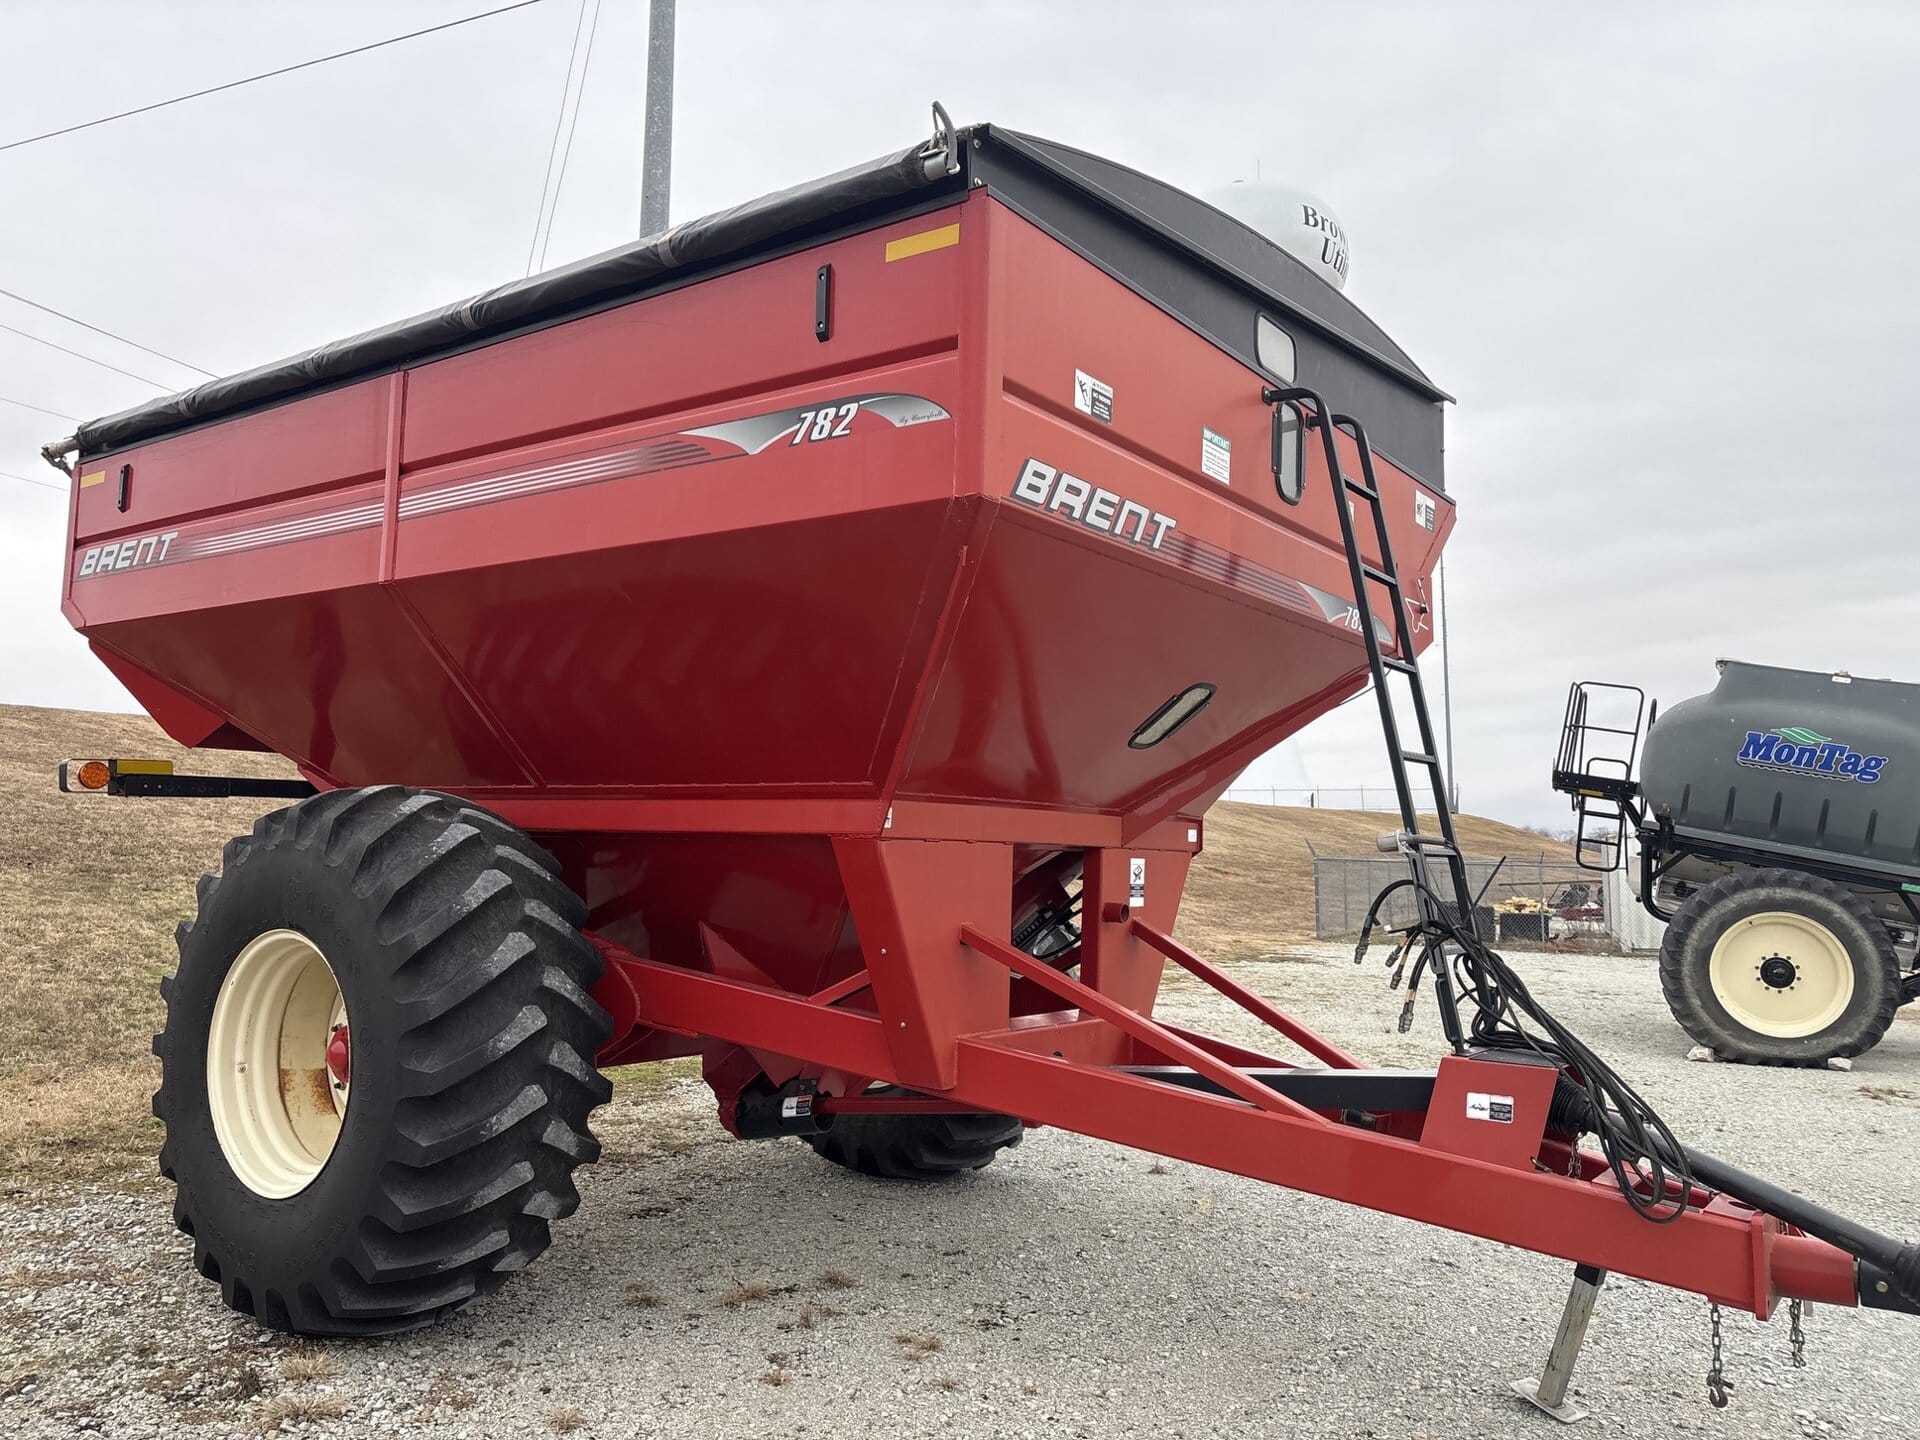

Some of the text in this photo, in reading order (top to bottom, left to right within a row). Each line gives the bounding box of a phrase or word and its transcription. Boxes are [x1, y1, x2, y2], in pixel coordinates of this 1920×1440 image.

[790, 402, 860, 446] 782
[1011, 457, 1177, 551] BRENT
[78, 531, 179, 577] BRENT
[1344, 605, 1364, 633] 78
[1737, 731, 1889, 784] MonTag
